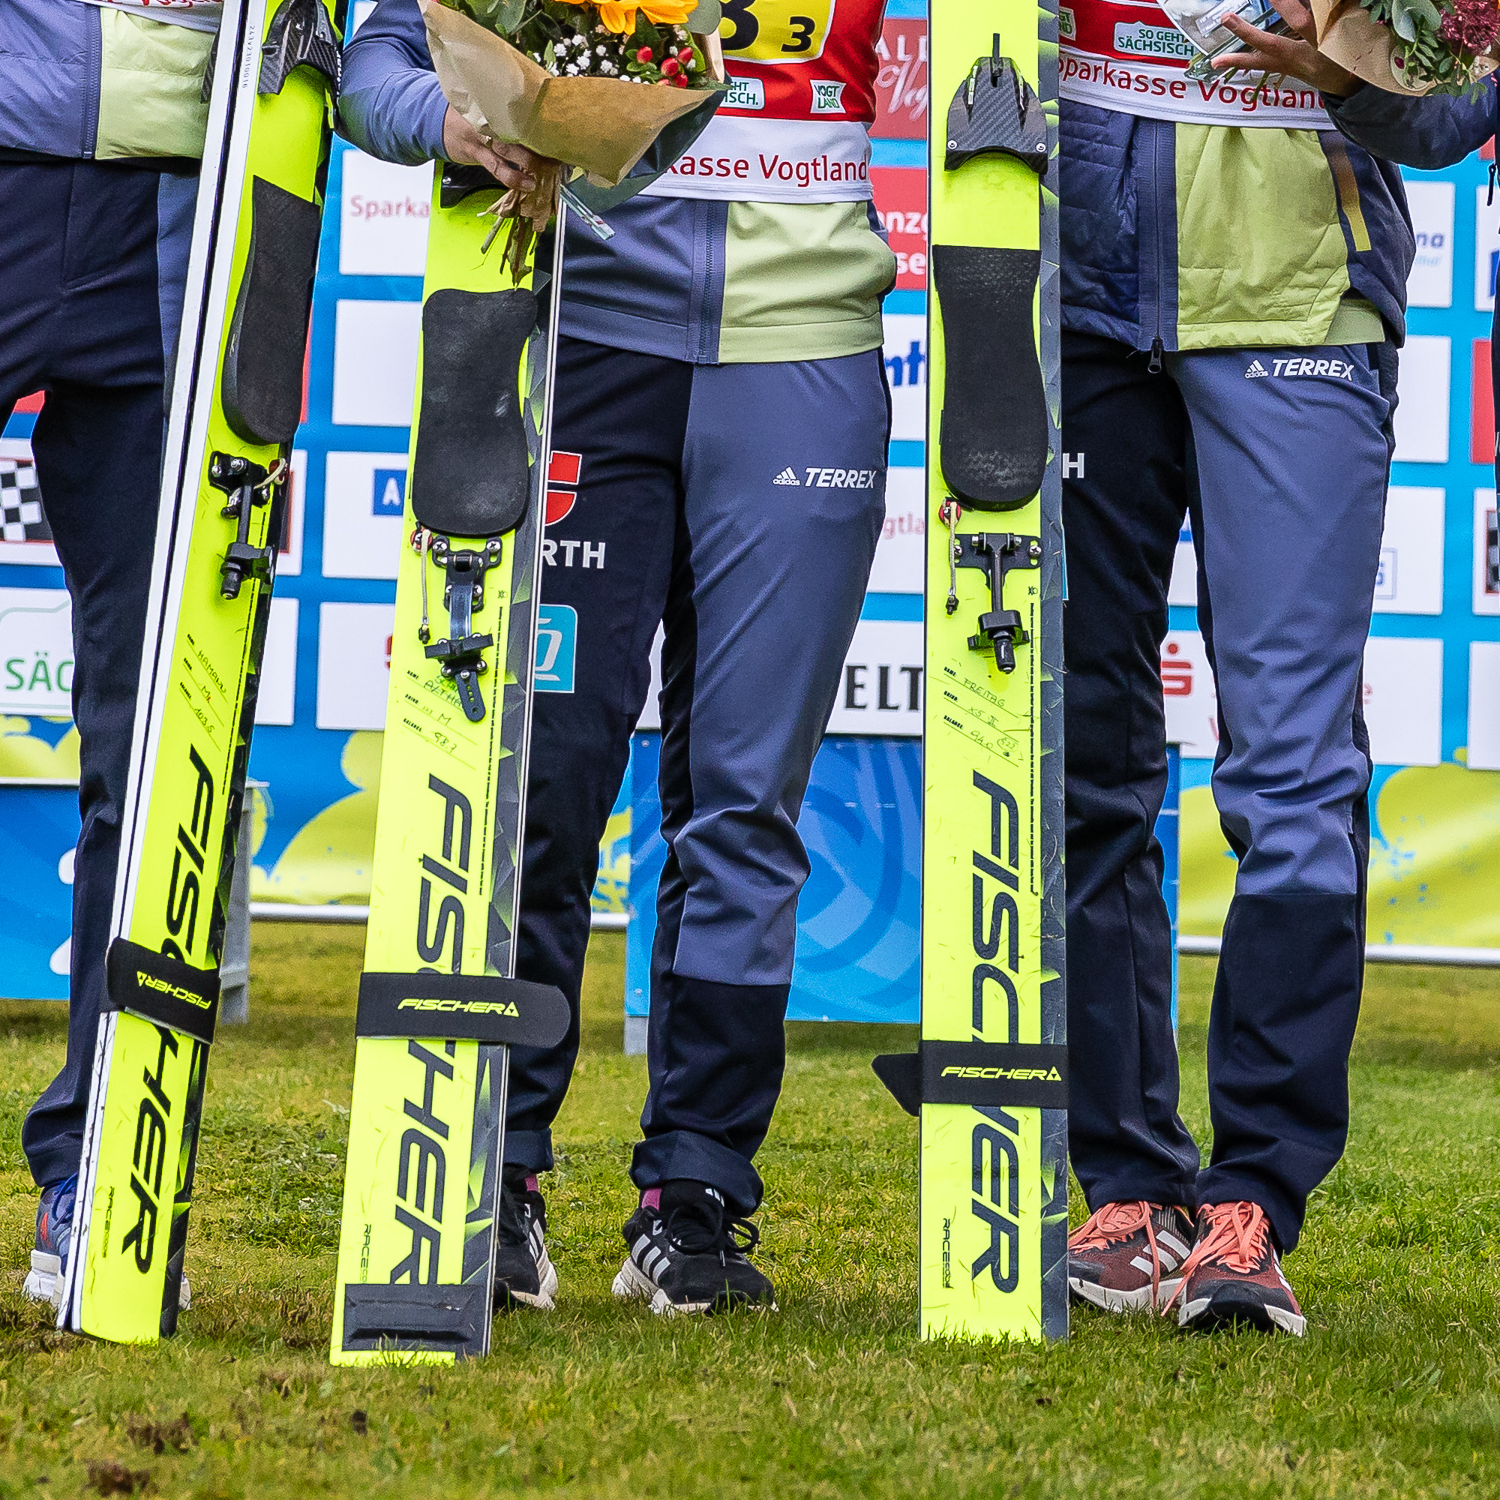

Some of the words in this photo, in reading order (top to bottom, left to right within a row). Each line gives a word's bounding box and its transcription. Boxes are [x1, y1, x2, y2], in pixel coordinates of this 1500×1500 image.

[781, 16, 817, 53] 3
[1138, 28, 1154, 40] SO
[1156, 30, 1186, 43] GEHT
[758, 153, 868, 188] Vogtland
[1271, 358, 1355, 381] TERREX
[804, 467, 877, 489] TERREX
[964, 677, 1006, 708] FREITAG
[145, 972, 212, 1009] FISCHER
[397, 997, 505, 1014] FISCHER
[121, 744, 214, 1275] FISHER
[390, 772, 473, 1286] FISHER
[971, 768, 1019, 1294] FISCER
[940, 1065, 1048, 1081] FISCHER
